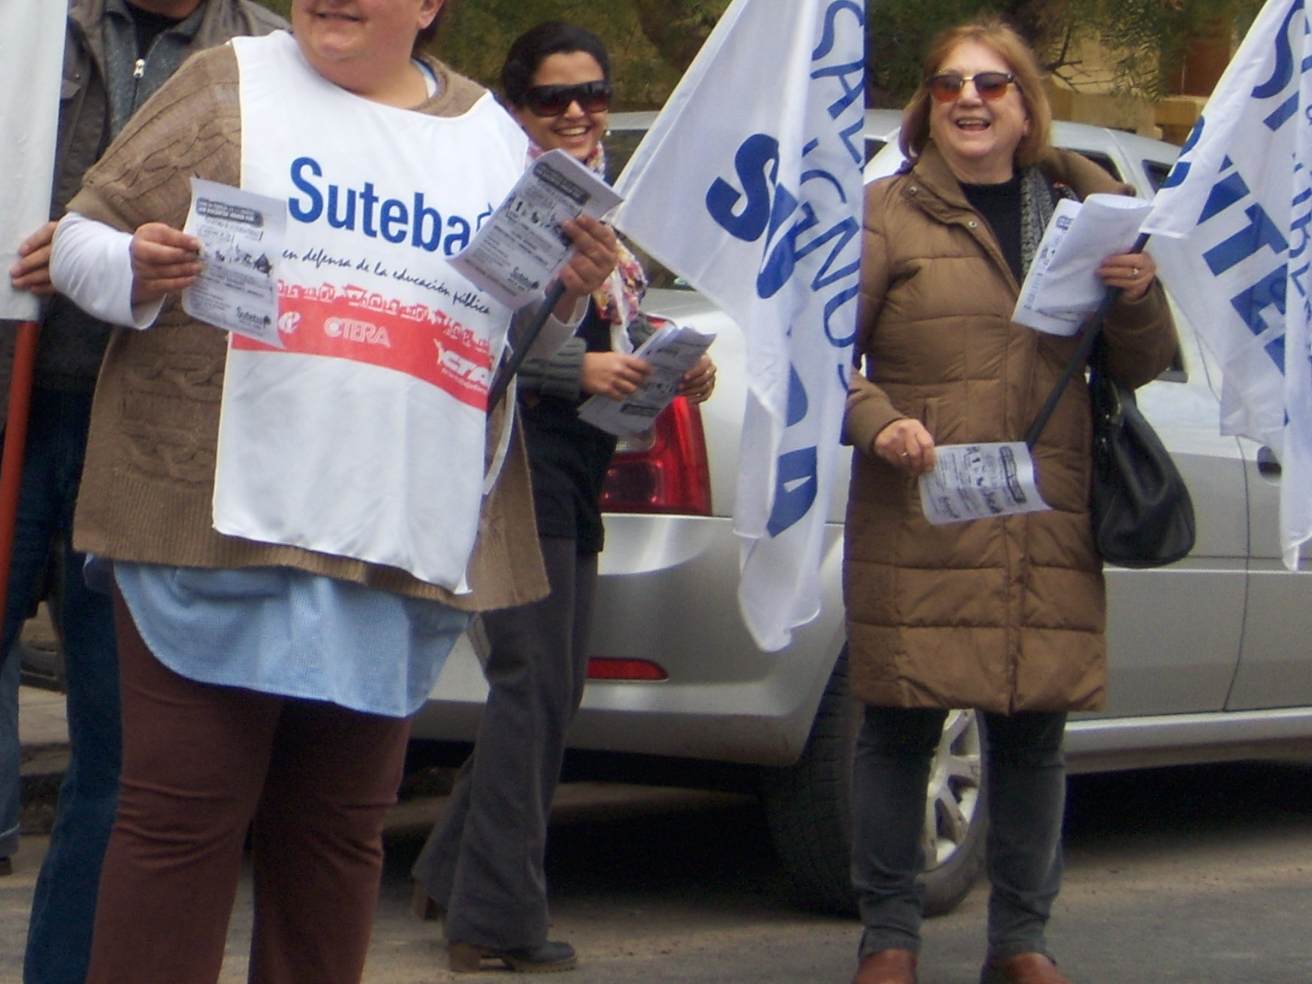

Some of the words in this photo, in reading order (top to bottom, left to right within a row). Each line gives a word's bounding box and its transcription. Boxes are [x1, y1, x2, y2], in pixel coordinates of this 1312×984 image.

[287, 156, 471, 257] Suteba
[282, 249, 299, 260] en
[302, 248, 351, 269] defensa
[356, 258, 370, 272] de
[374, 262, 388, 277] la
[392, 268, 450, 297] educación
[452, 291, 491, 315] pública
[324, 315, 391, 348] CTERA
[441, 349, 489, 387] CTA
